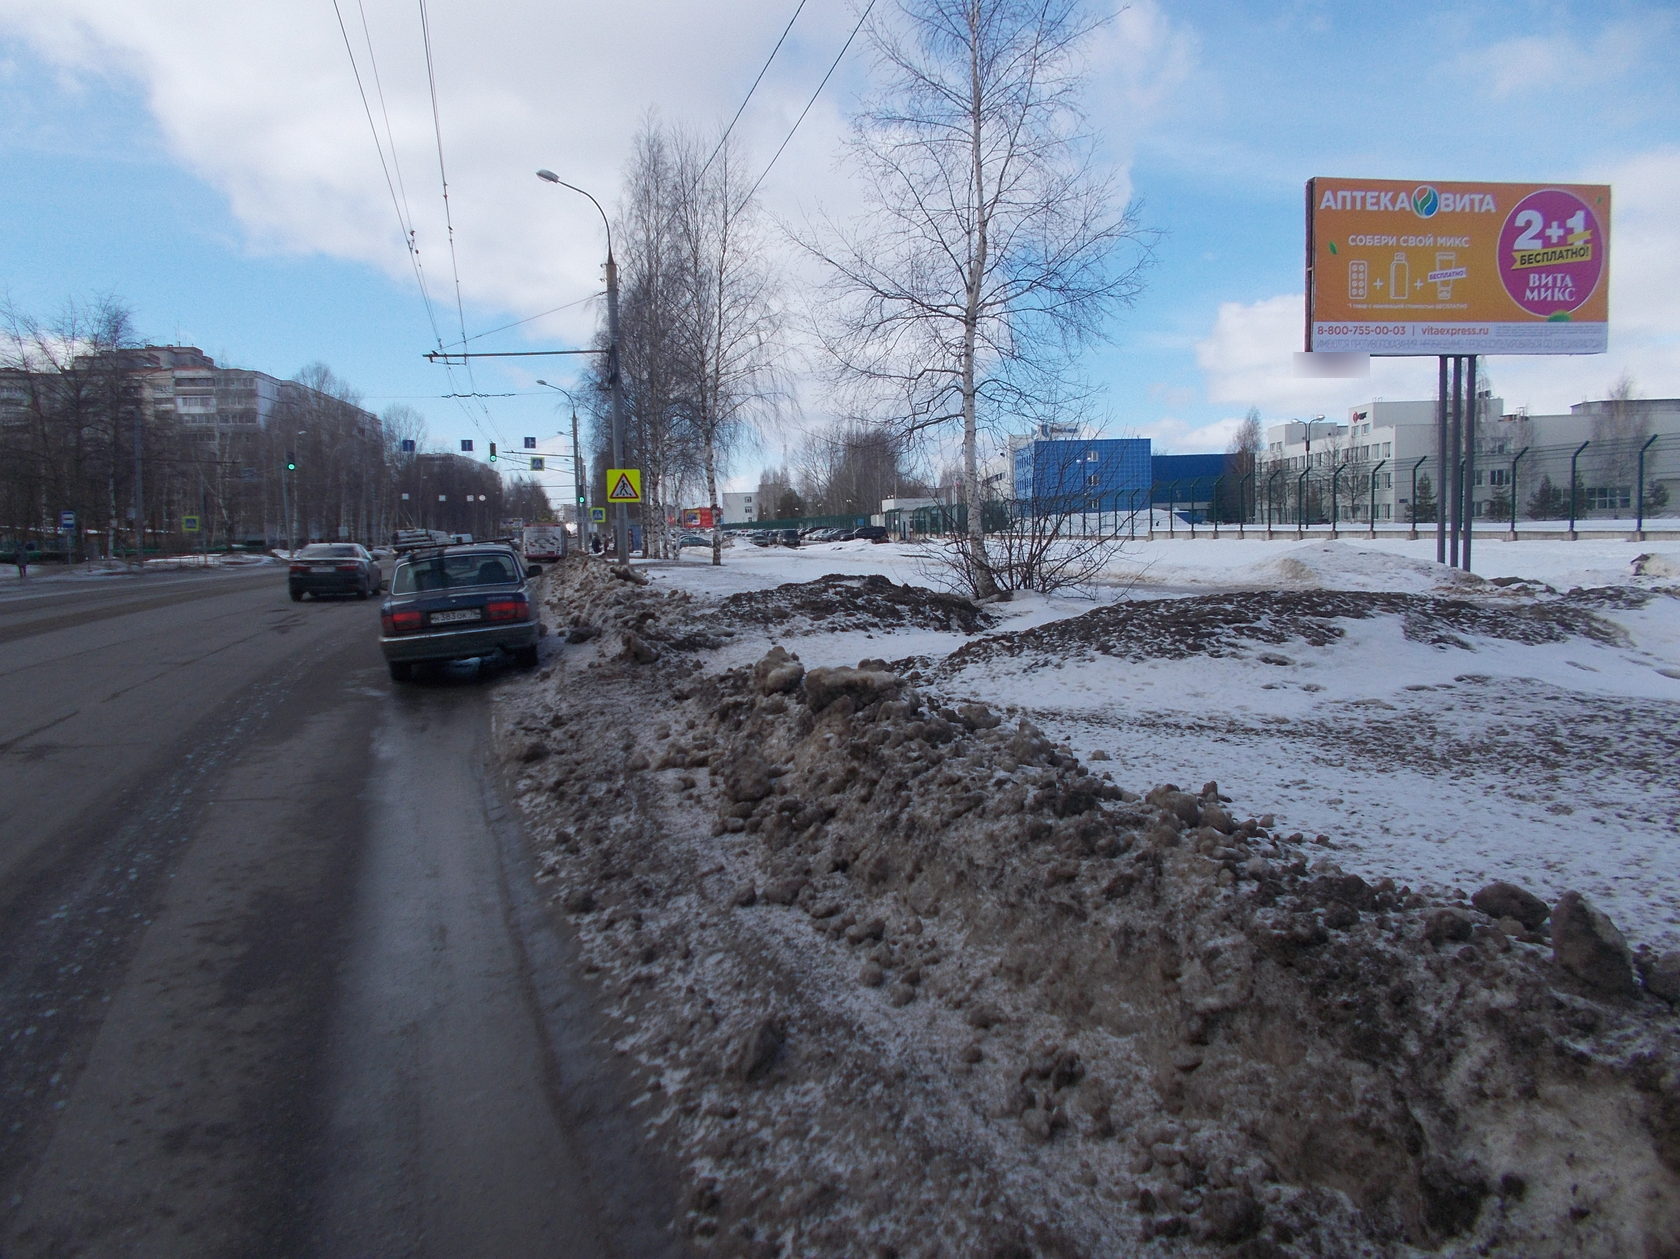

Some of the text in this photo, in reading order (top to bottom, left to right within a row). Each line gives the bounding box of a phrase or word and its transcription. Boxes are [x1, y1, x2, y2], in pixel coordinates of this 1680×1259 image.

[1319, 190, 1496, 213] АПТЕКА ВИТА
[1513, 209, 1586, 250] 2+1
[1348, 233, 1470, 248] СОБЕРИ СВОЙ МИКС
[1519, 246, 1590, 266] БЕСПЛАТНО!
[1528, 273, 1573, 287] ВИТА
[1523, 287, 1576, 301] МИКС
[1317, 325, 1406, 336] 8-800-755-00-03
[1421, 325, 1489, 337] vitaexpress.ru
